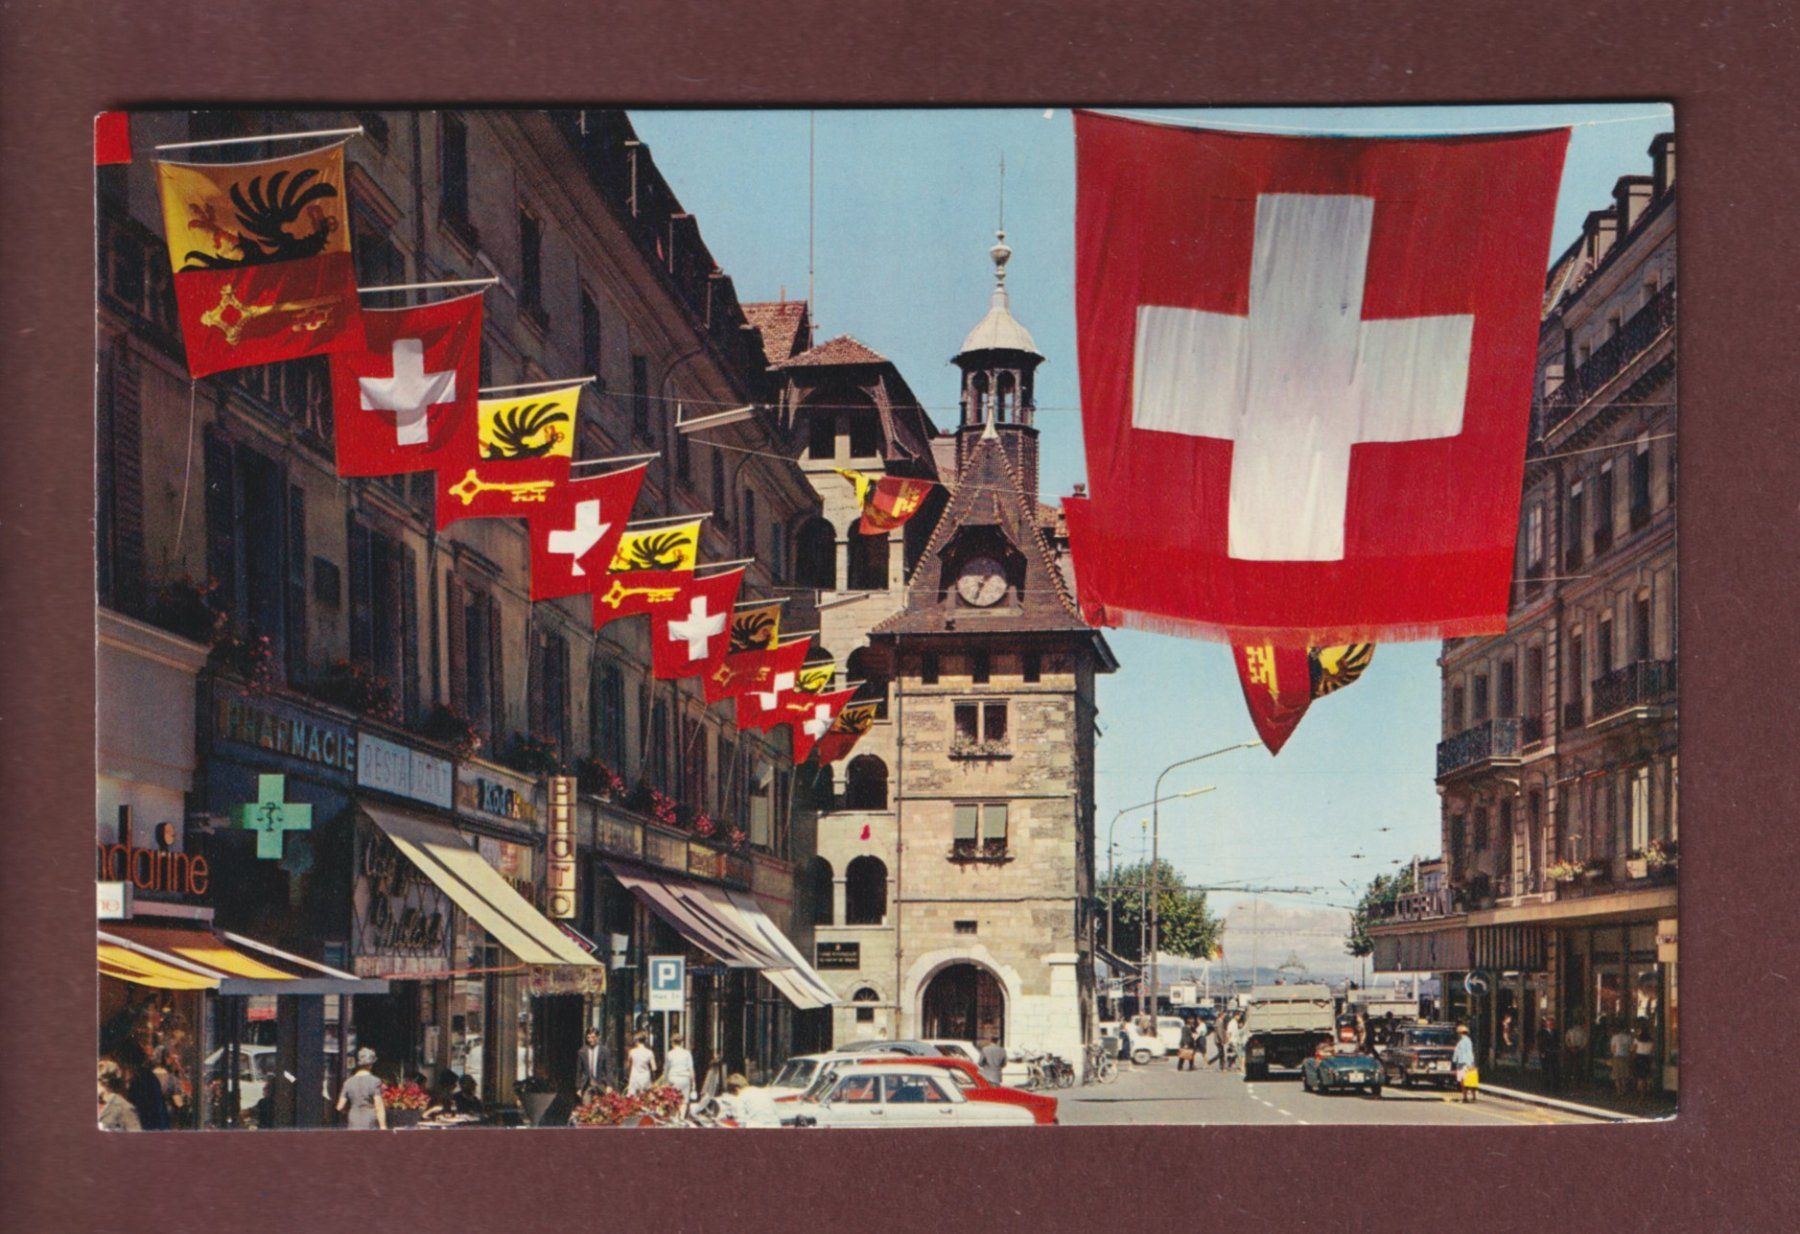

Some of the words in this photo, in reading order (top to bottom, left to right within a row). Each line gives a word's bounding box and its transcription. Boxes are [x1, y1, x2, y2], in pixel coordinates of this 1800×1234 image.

[219, 698, 355, 771] PHARMACIE
[551, 777, 571, 915] PHOTO
[658, 963, 676, 988] P
